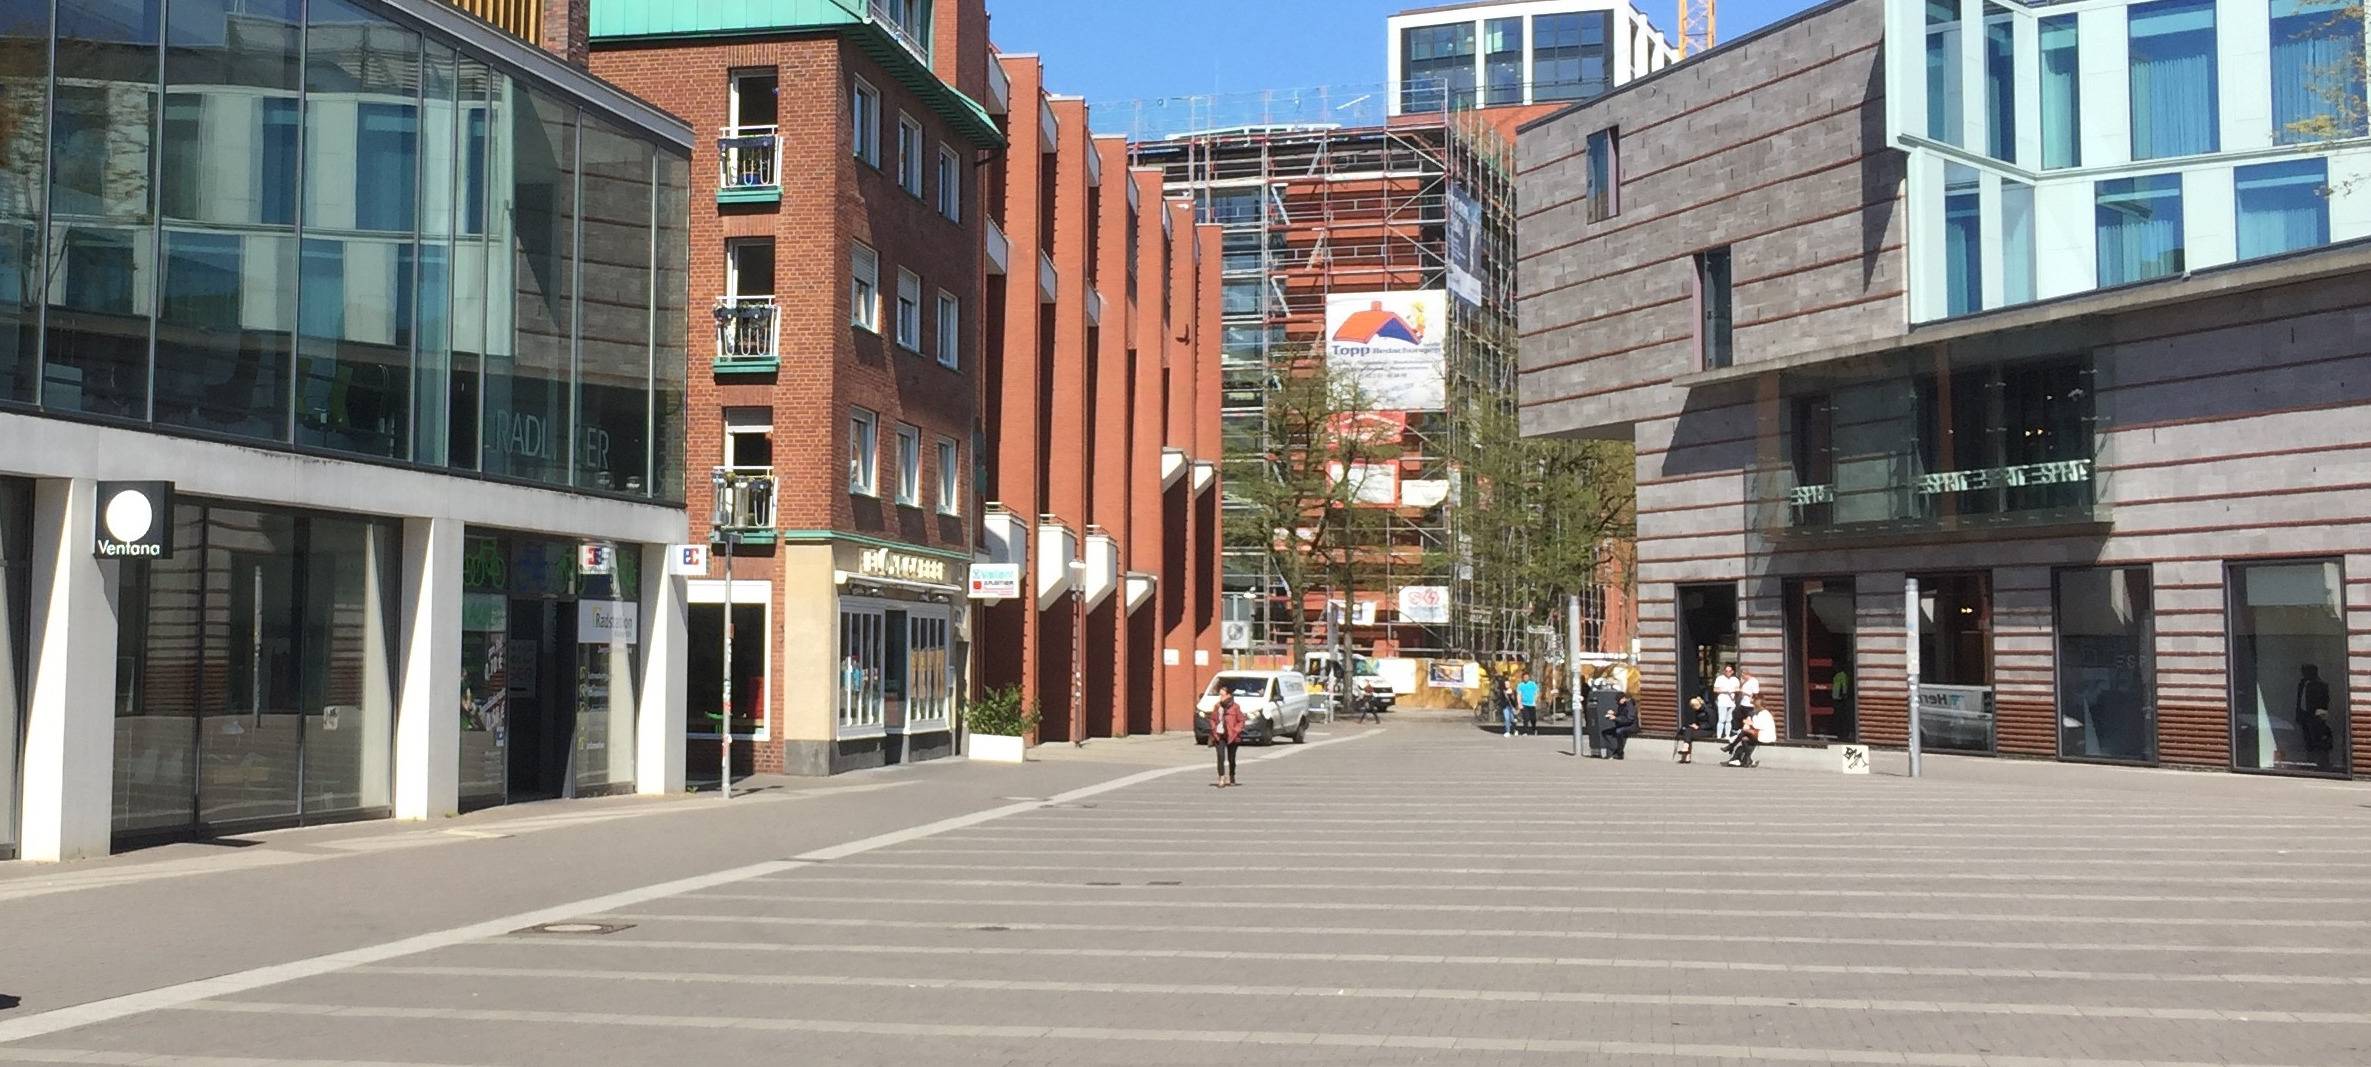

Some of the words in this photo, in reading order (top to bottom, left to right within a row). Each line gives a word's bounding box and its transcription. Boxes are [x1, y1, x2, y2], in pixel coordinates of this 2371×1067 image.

[1331, 345, 1370, 357] Topp
[496, 409, 609, 470] RADLER
[2031, 459, 2092, 485] ESPRIT
[97, 539, 160, 556] Ventana
